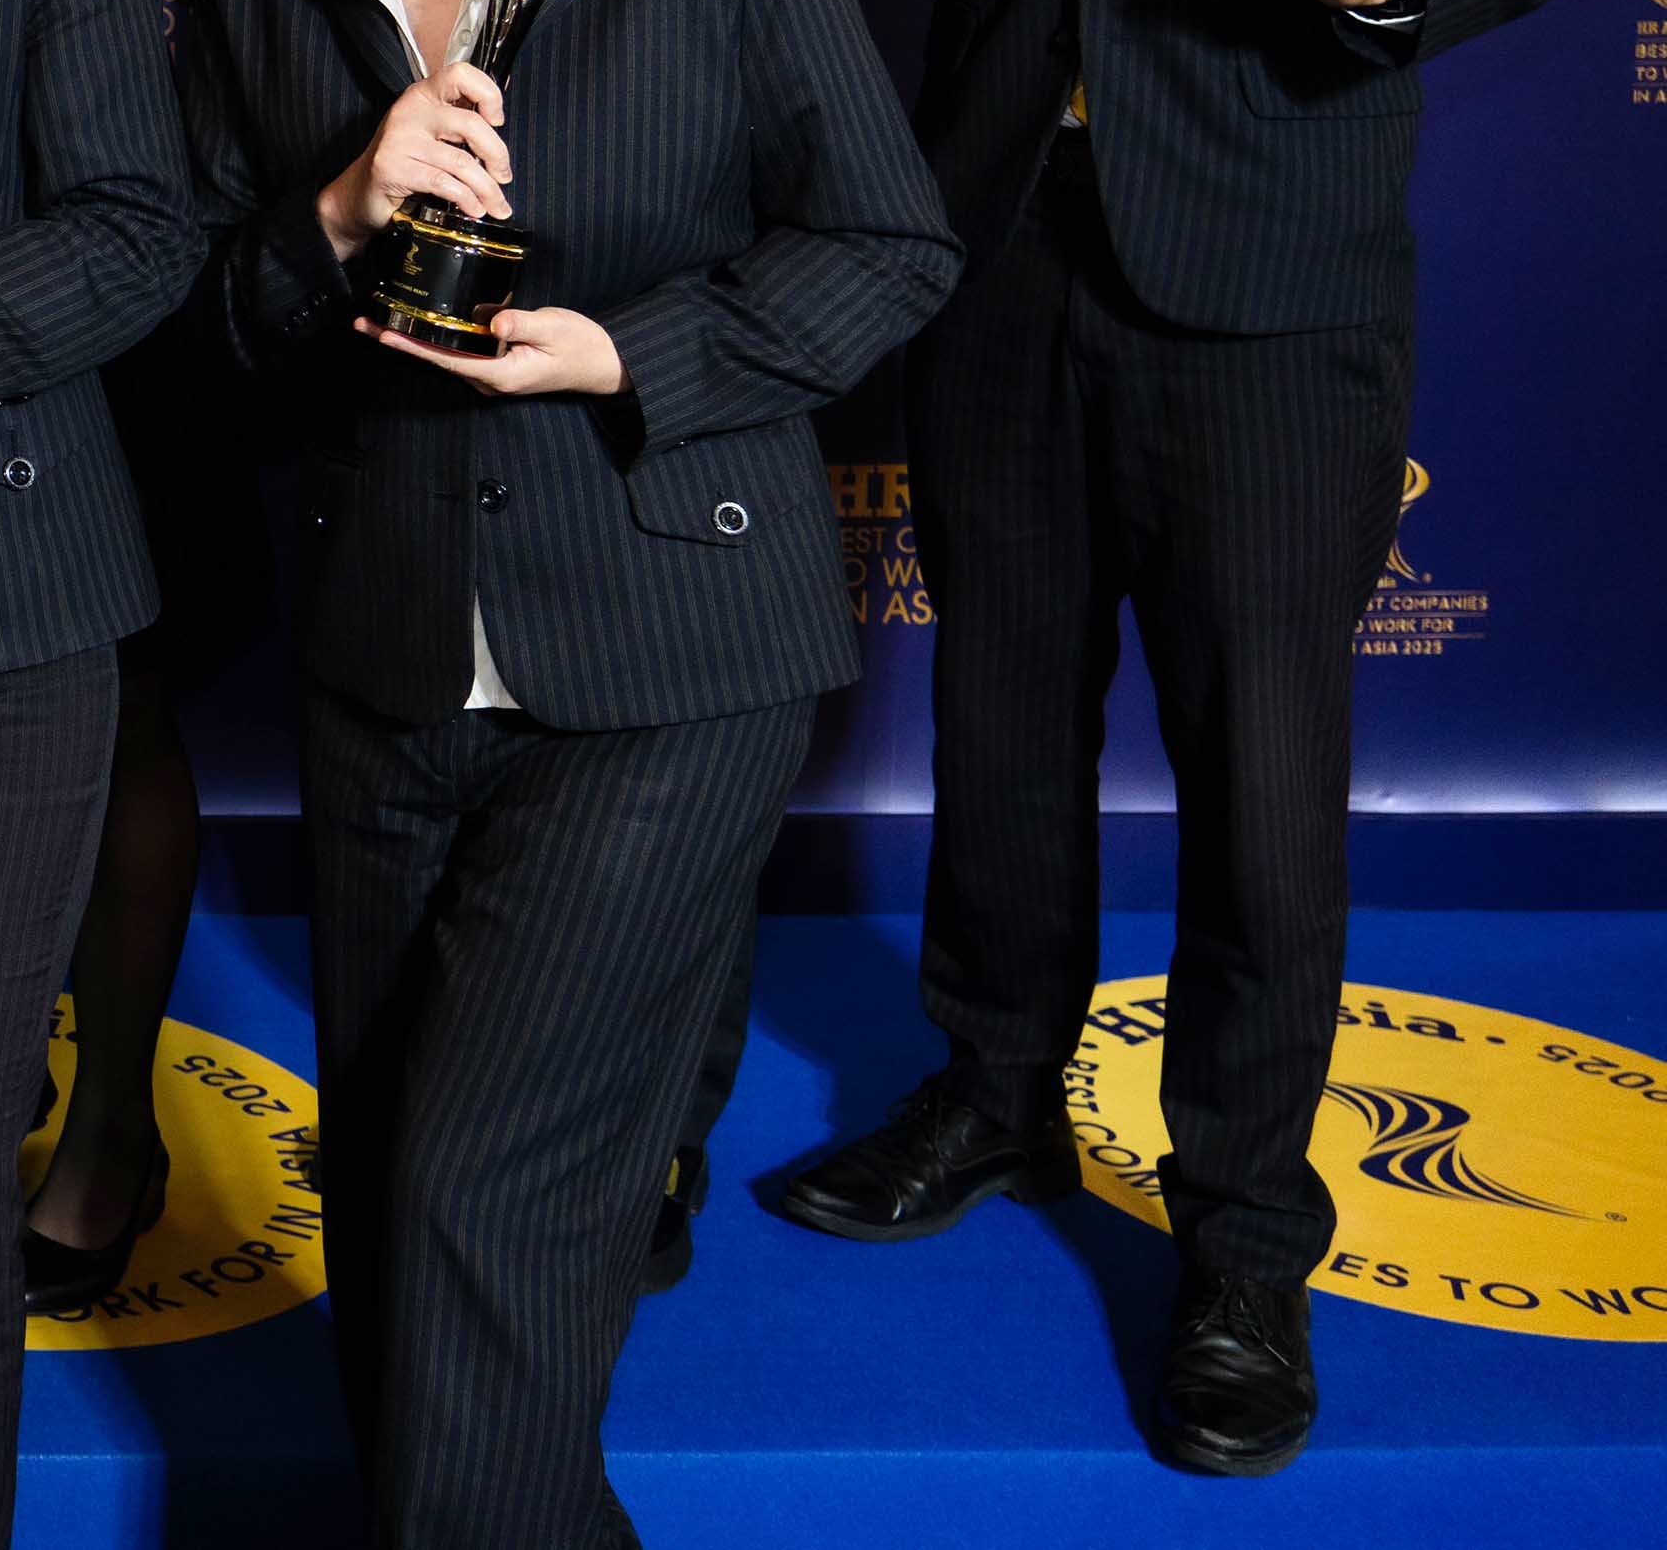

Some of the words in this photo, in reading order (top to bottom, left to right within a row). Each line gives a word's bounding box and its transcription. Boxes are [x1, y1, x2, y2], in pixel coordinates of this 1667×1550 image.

[1635, 43, 1667, 59] BES
[1636, 66, 1657, 81] TO
[1633, 89, 1650, 104] IN
[840, 527, 886, 553] EST
[1390, 596, 1489, 611] COMPANIES
[1369, 618, 1416, 632] WORK
[1421, 618, 1454, 632] FOR
[1361, 640, 1398, 655] ASIA
[1403, 640, 1443, 655] 2025
[173, 1054, 292, 1118] 2025
[264, 1204, 321, 1240] IN
[179, 1240, 296, 1298] FOR
[1438, 1274, 1540, 1310] TO
